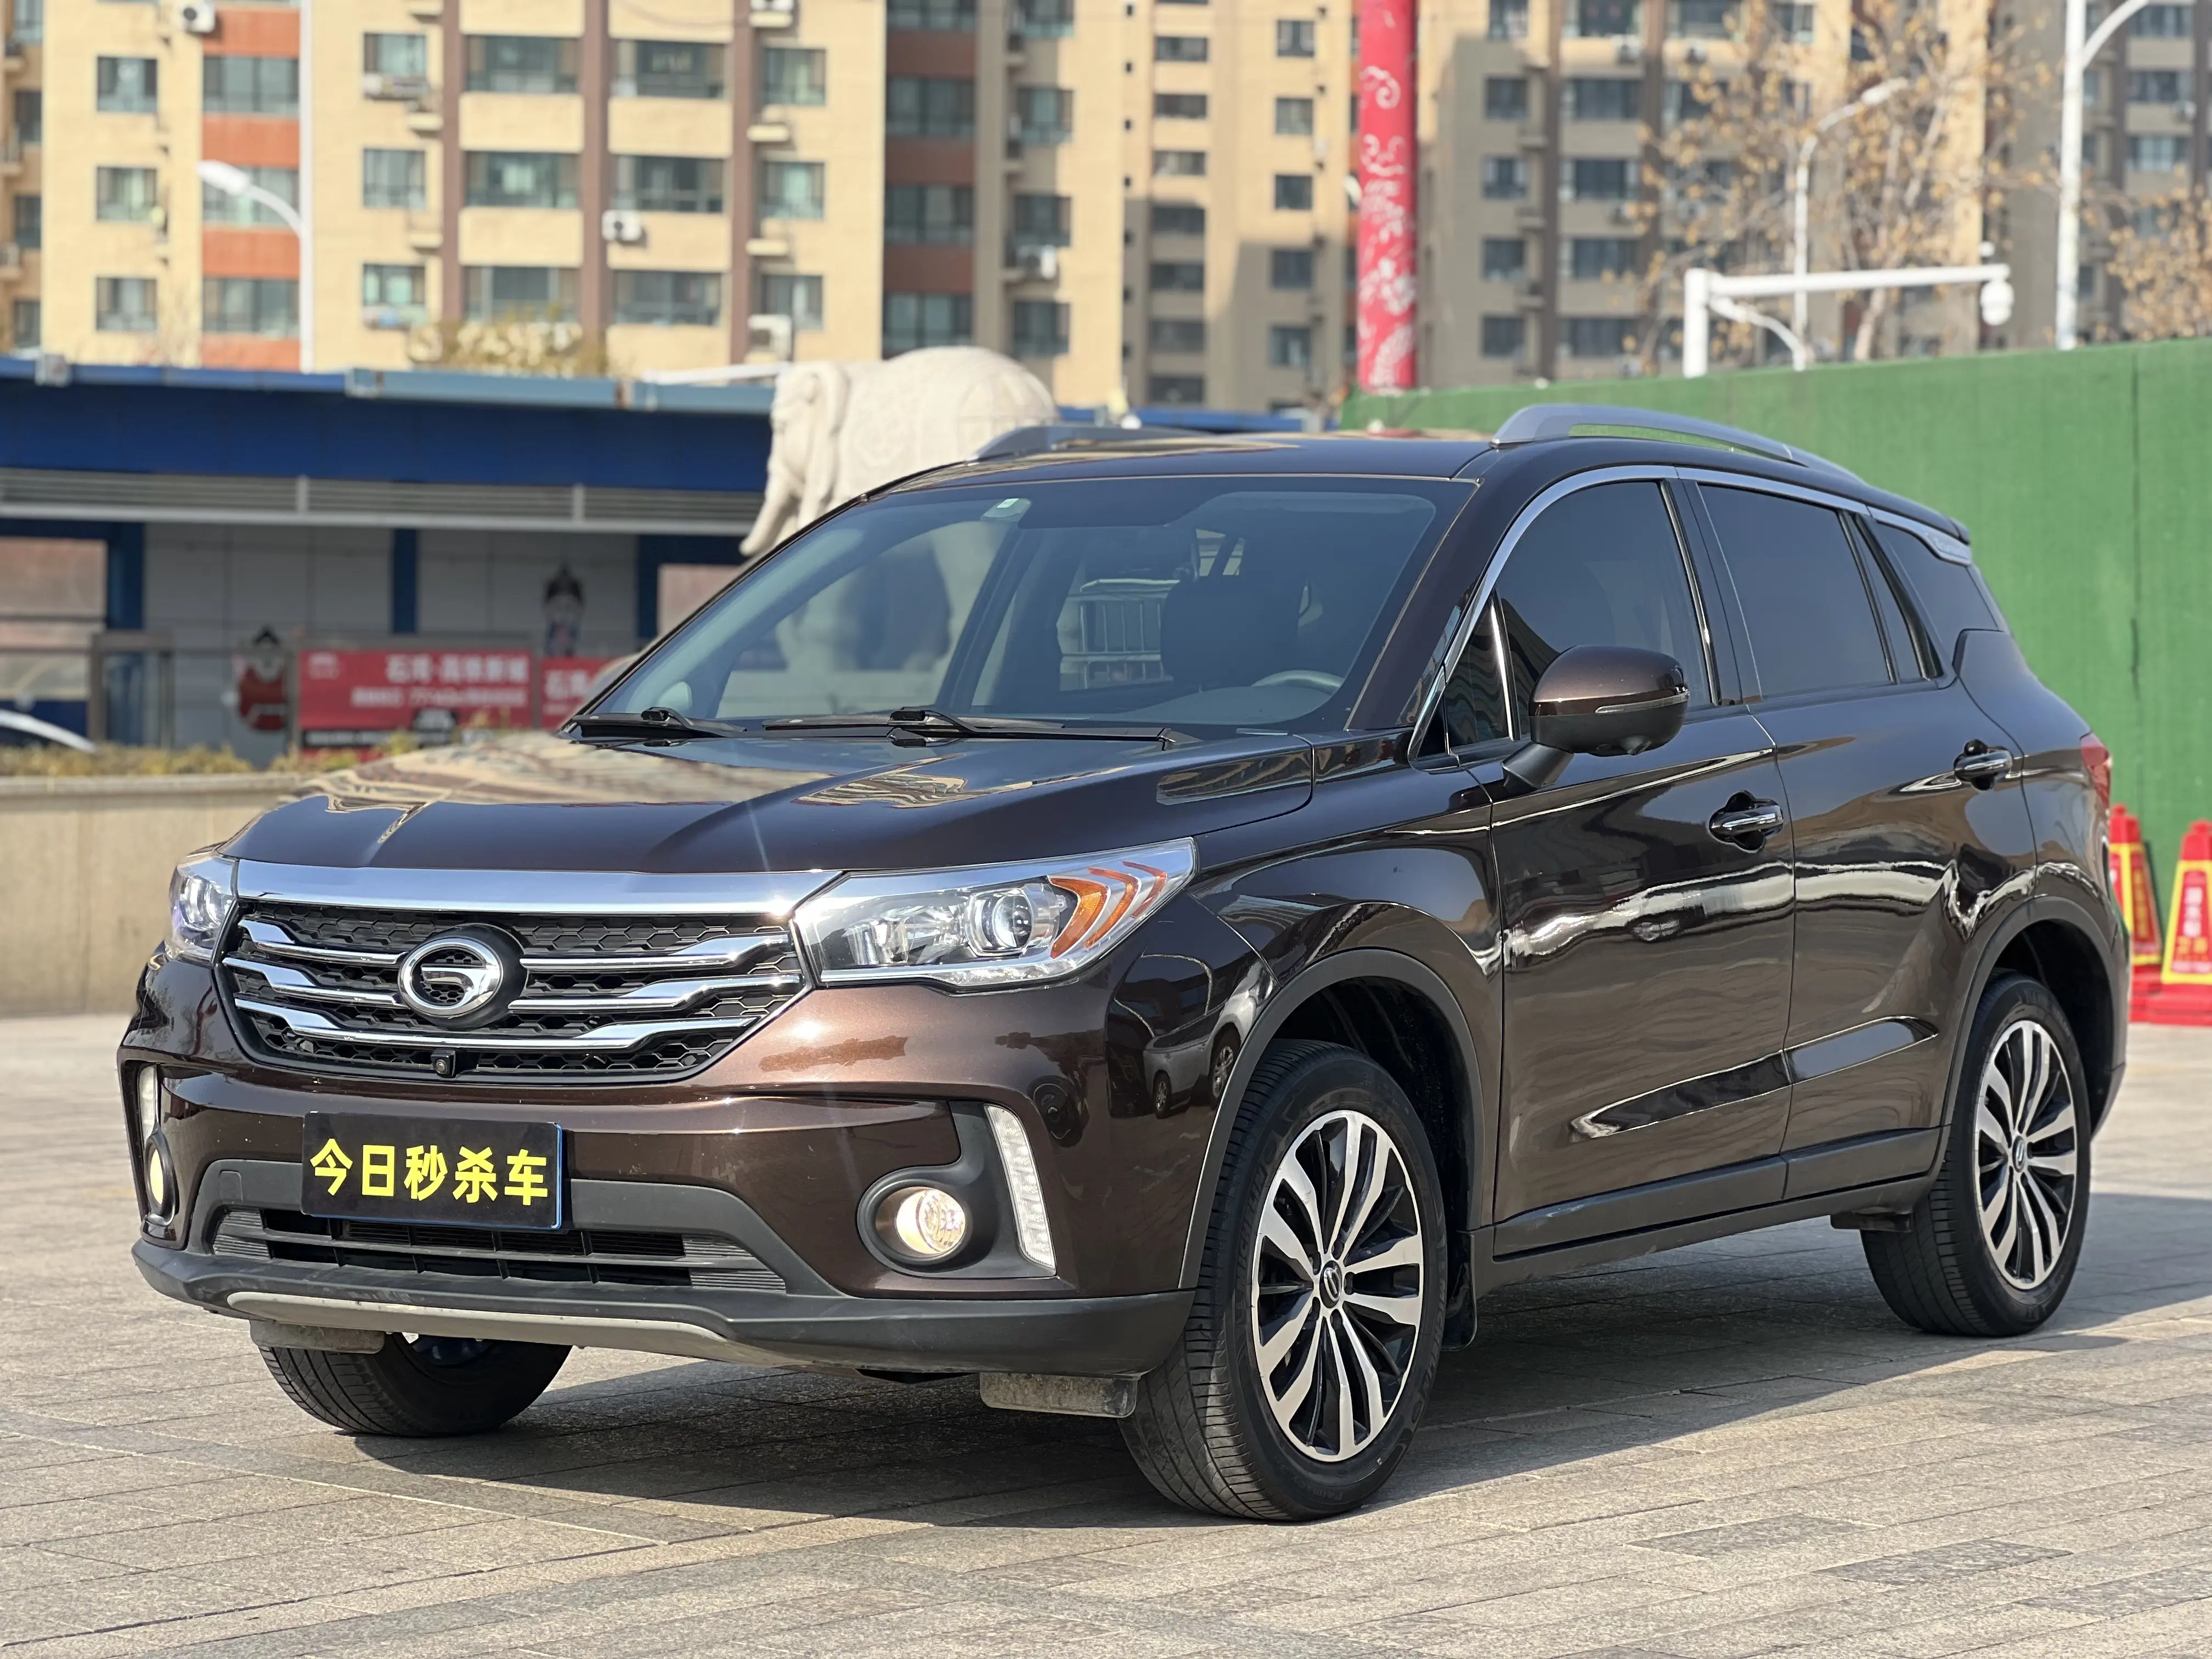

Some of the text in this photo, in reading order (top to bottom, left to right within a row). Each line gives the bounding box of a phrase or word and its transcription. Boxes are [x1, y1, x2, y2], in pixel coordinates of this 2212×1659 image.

[309, 1138, 548, 1206] 今日秒杀车
[1235, 1164, 1267, 1292] MICHELIN
[1417, 1277, 1446, 1400] MICHELIN
